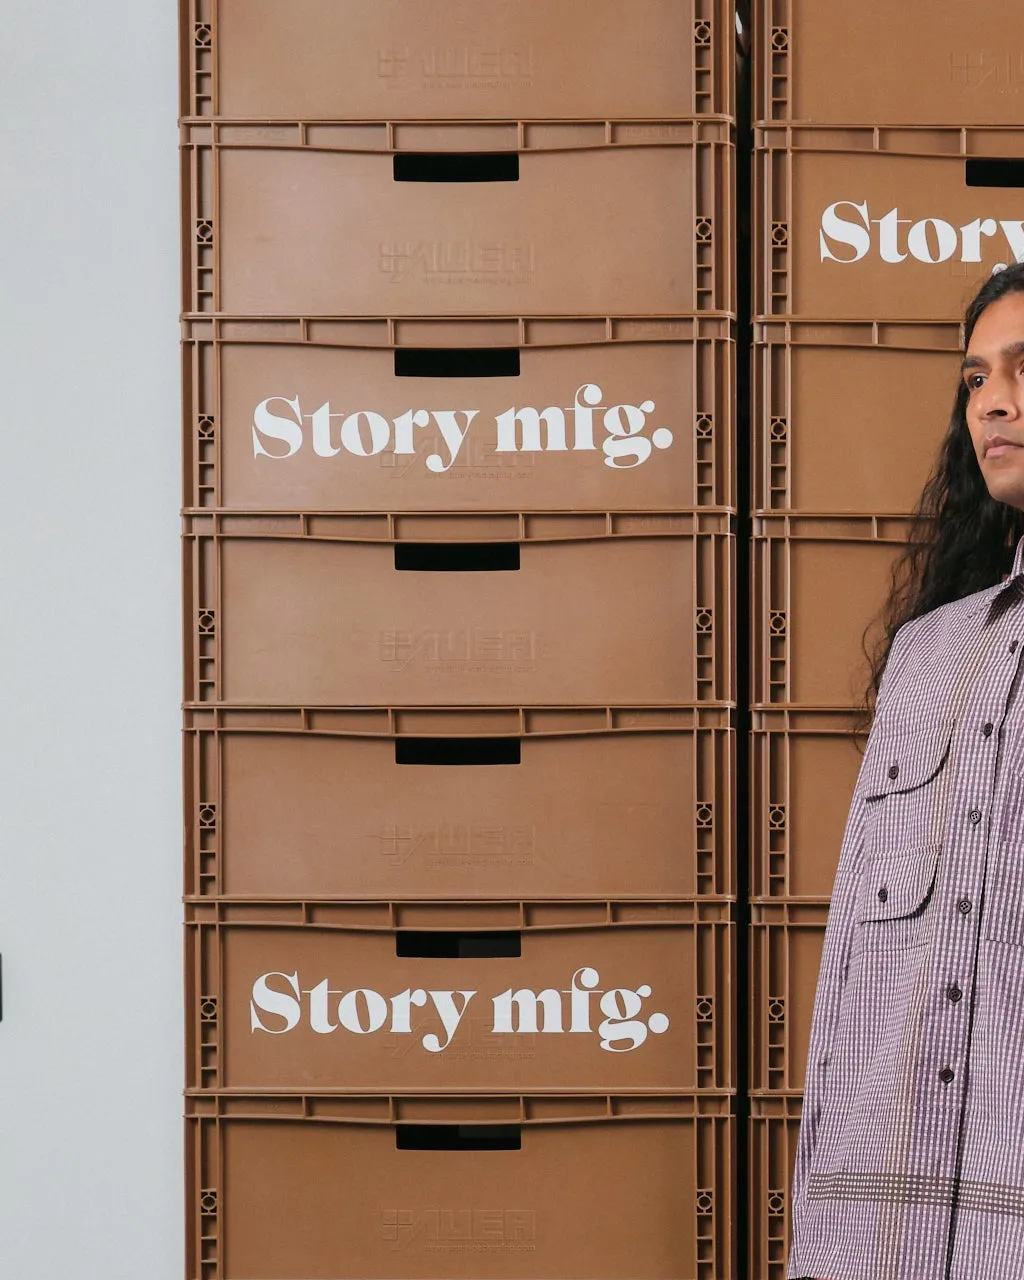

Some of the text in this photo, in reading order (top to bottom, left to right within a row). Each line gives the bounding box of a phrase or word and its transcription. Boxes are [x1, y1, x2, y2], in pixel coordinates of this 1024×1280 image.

[250, 394, 479, 472] Story
[494, 384, 673, 469] mfg.
[250, 971, 477, 1052] Story
[492, 967, 669, 1052] mfg.
